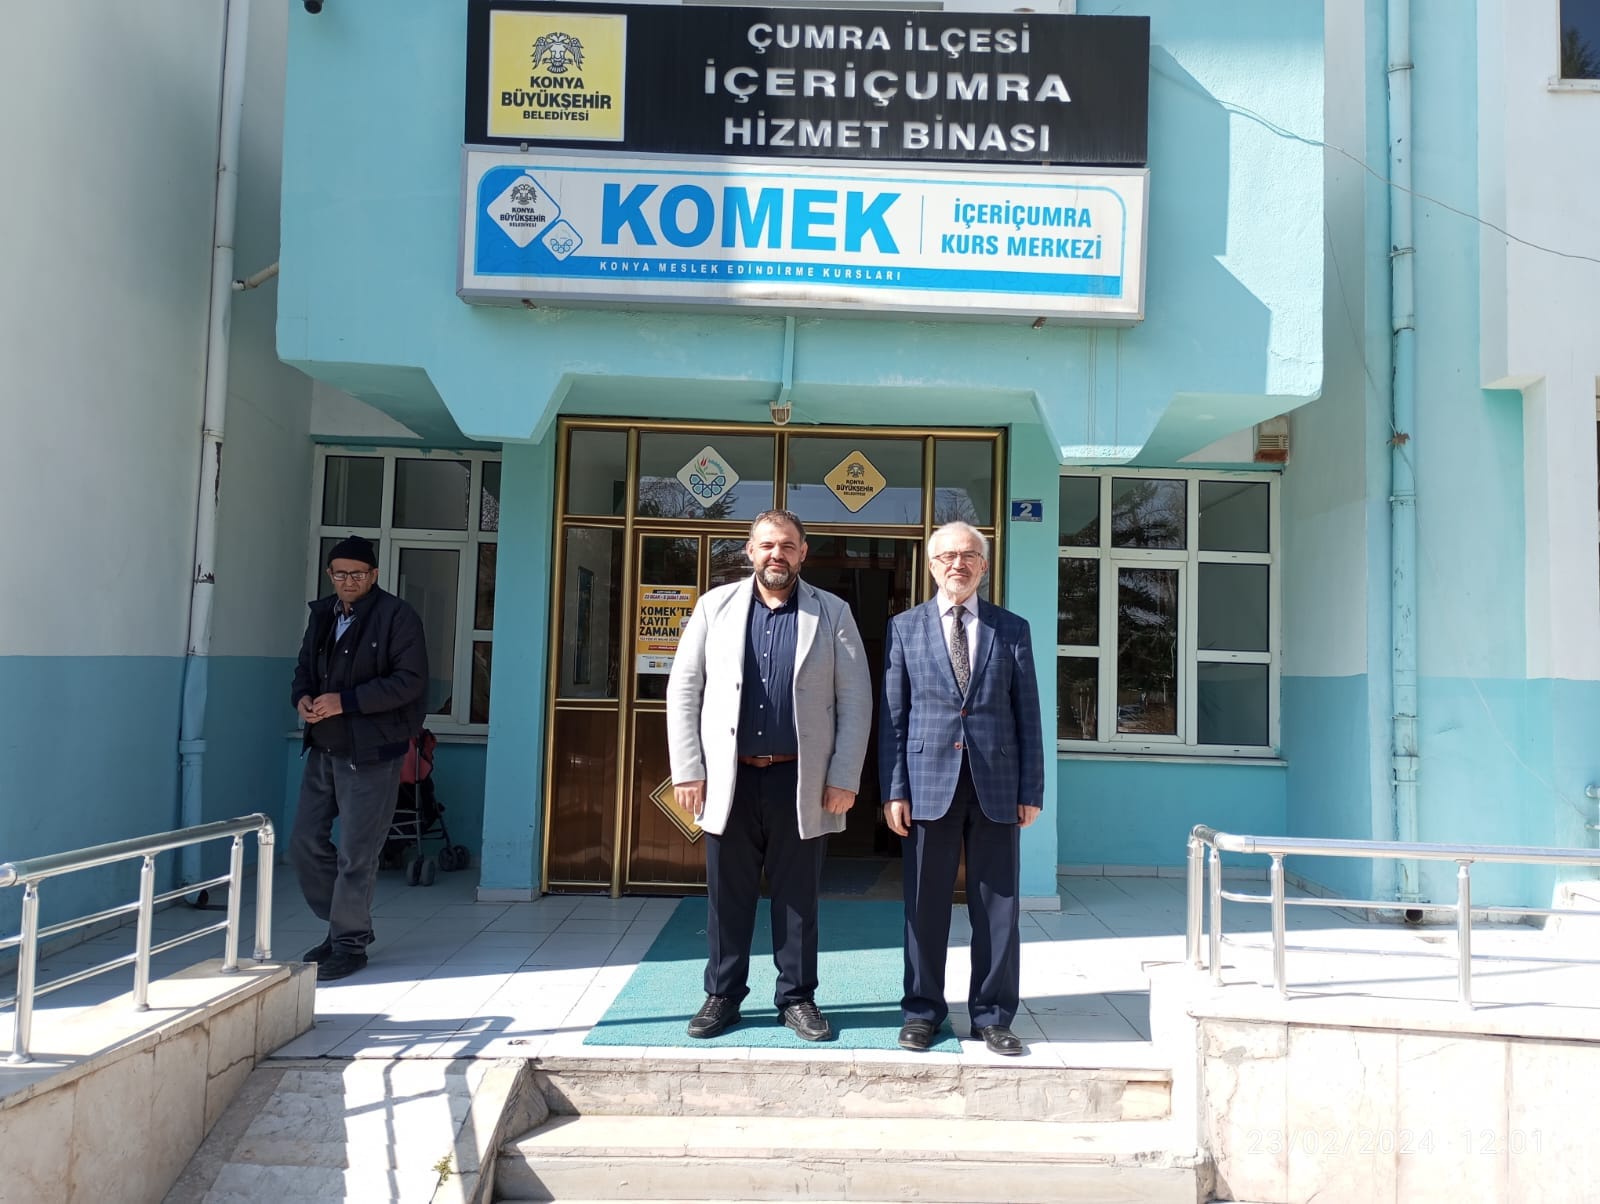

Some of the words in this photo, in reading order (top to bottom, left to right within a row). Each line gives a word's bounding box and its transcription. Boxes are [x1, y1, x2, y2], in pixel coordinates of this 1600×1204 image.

[747, 23, 891, 53] ÇUMRA
[904, 21, 1030, 59] İLÇESİ
[530, 76, 584, 89] KONYA
[704, 58, 1072, 106] İÇERİÇUMRA
[501, 89, 612, 110] BÜYÜKŞEHİR
[523, 110, 589, 121] BELEDİYESİ
[724, 110, 889, 149] HİZMET
[903, 114, 1050, 152] BİNASI
[500, 213, 546, 223] BÜYÜKŞEHİR
[601, 183, 902, 254] KOMEK
[954, 198, 1092, 231] İÇERİÇUMRA
[941, 234, 999, 256] KURS
[1007, 235, 1102, 260] MERKEZİ
[600, 261, 649, 272] KONYA
[658, 263, 719, 274] MESLEK
[727, 264, 814, 277] EDİNDİRME
[823, 266, 901, 281] KURSLARI
[1020, 503, 1033, 517] 2
[640, 606, 693, 617] KOMEK'TE
[640, 616, 670, 626] KAYIT
[639, 626, 680, 637] ZAMANI
